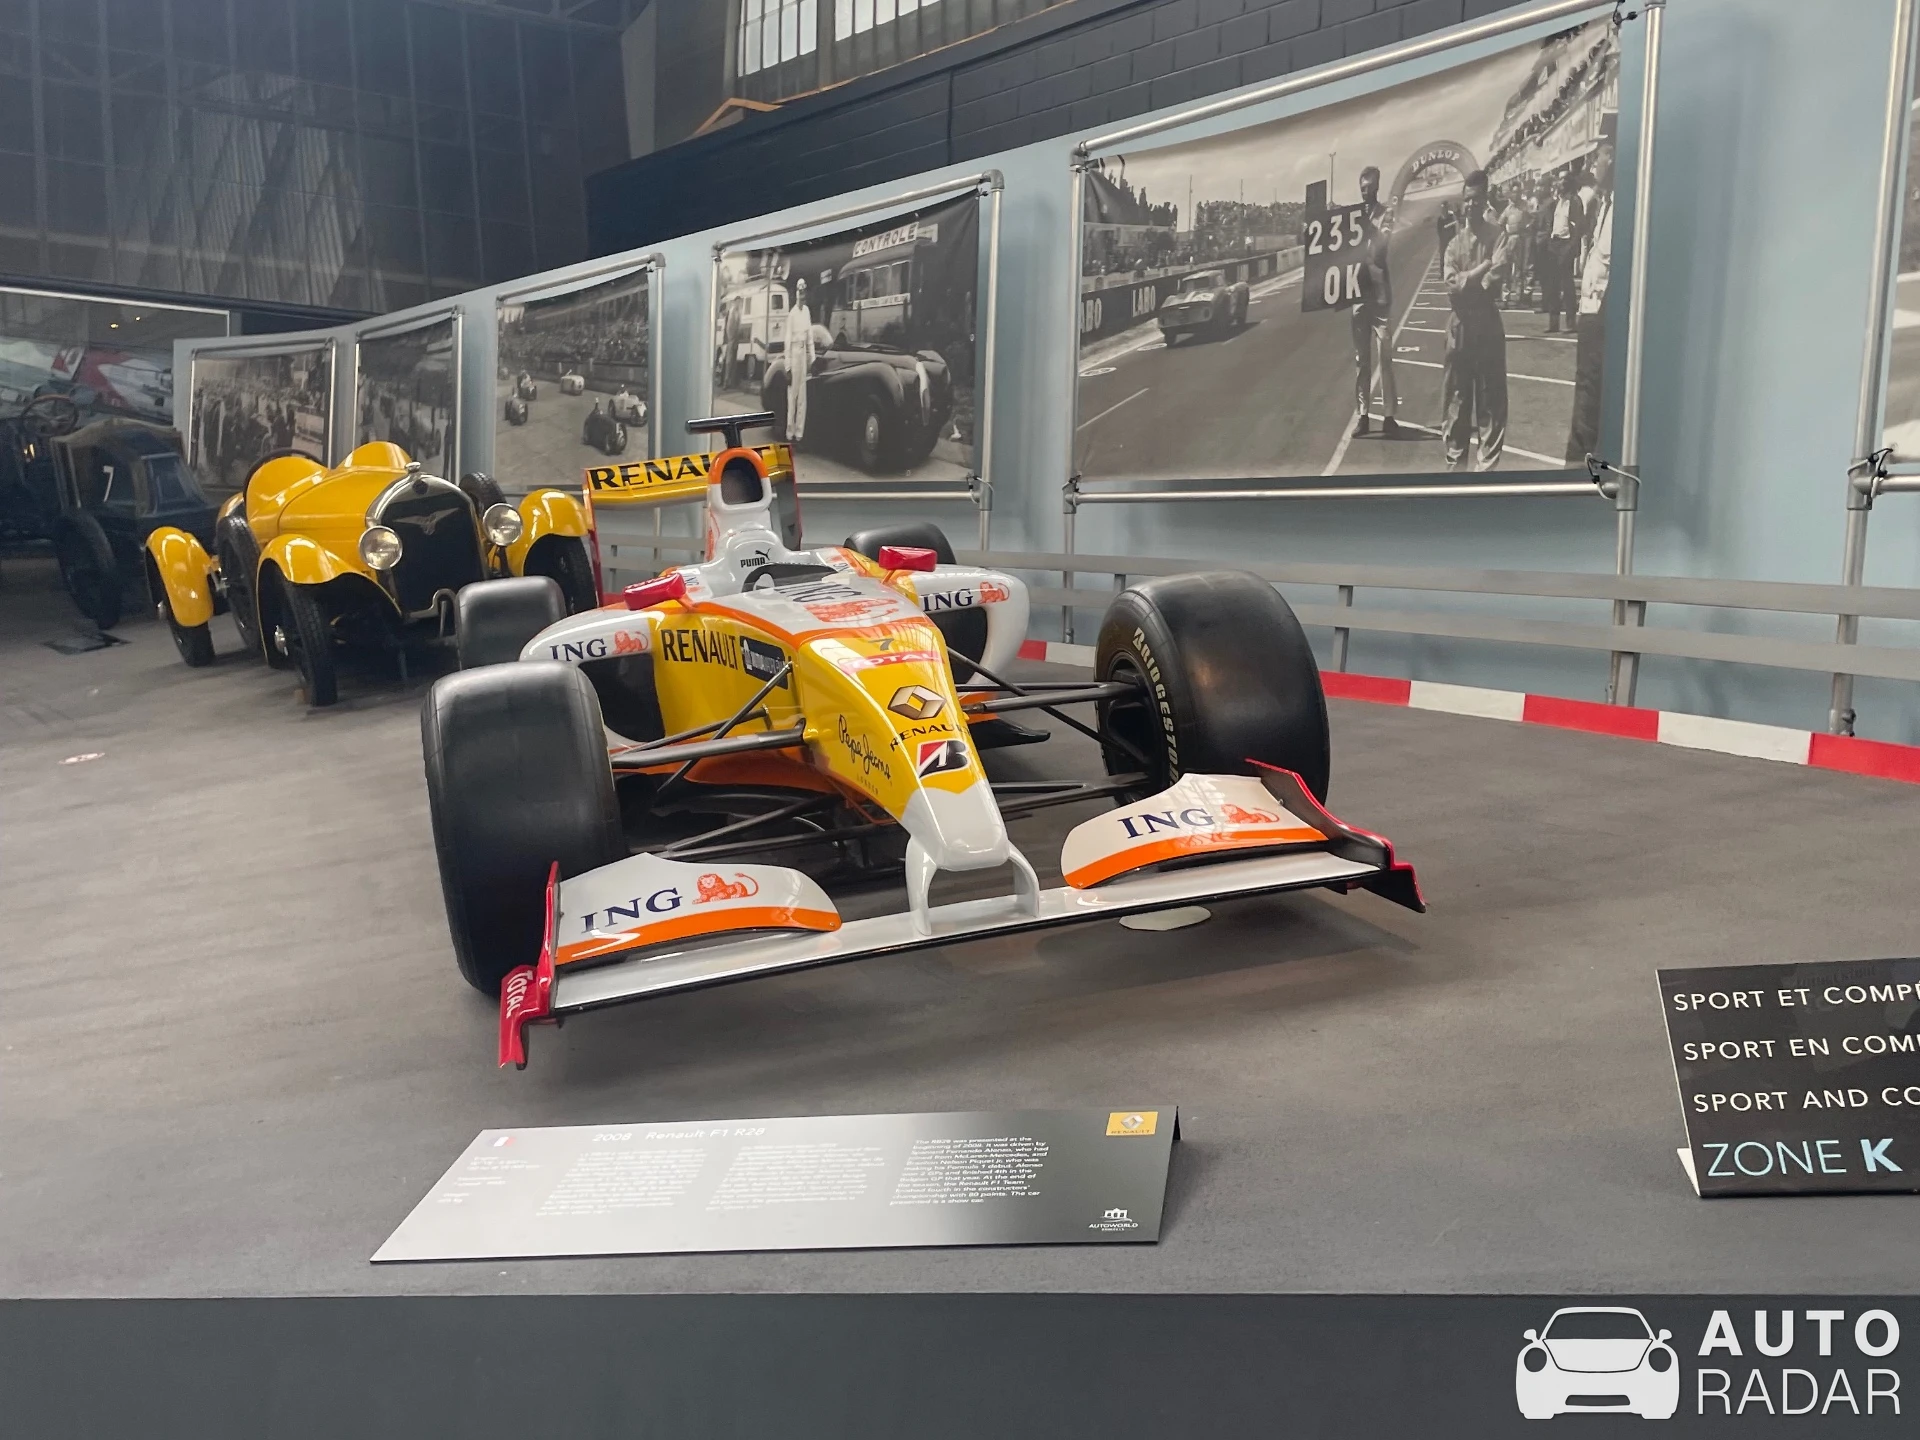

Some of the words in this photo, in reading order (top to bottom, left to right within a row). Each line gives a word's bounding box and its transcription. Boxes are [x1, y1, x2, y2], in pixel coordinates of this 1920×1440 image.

[1412, 150, 1460, 172] DUNLOP
[854, 224, 918, 255] CONTROLE
[1308, 210, 1364, 255] 235
[1324, 262, 1362, 305] OK
[740, 558, 766, 568] PUMA
[922, 588, 974, 612] ING
[550, 638, 607, 662] ING
[660, 630, 738, 670] RENAULT
[853, 653, 939, 668] TOTAL
[1132, 627, 1179, 786] BRIDGESTON
[838, 714, 863, 764] Pepe
[862, 734, 891, 780] Jeans
[1118, 808, 1216, 839] ING
[580, 887, 683, 932] ING
[506, 970, 534, 1018] TOTAL
[1673, 990, 1764, 1012] SPORT
[1778, 988, 1810, 1006] ET
[1684, 1040, 1776, 1061] SPORT
[1790, 1038, 1830, 1057] EN
[1842, 1034, 1920, 1054] COM
[1694, 1092, 1788, 1112] SPORT
[1803, 1089, 1869, 1109] AND
[592, 1132, 633, 1142] 2008
[645, 1129, 706, 1140] Renault
[710, 1128, 728, 1138] F1
[1703, 1140, 1847, 1177] ZONE
[1860, 1138, 1903, 1172] K
